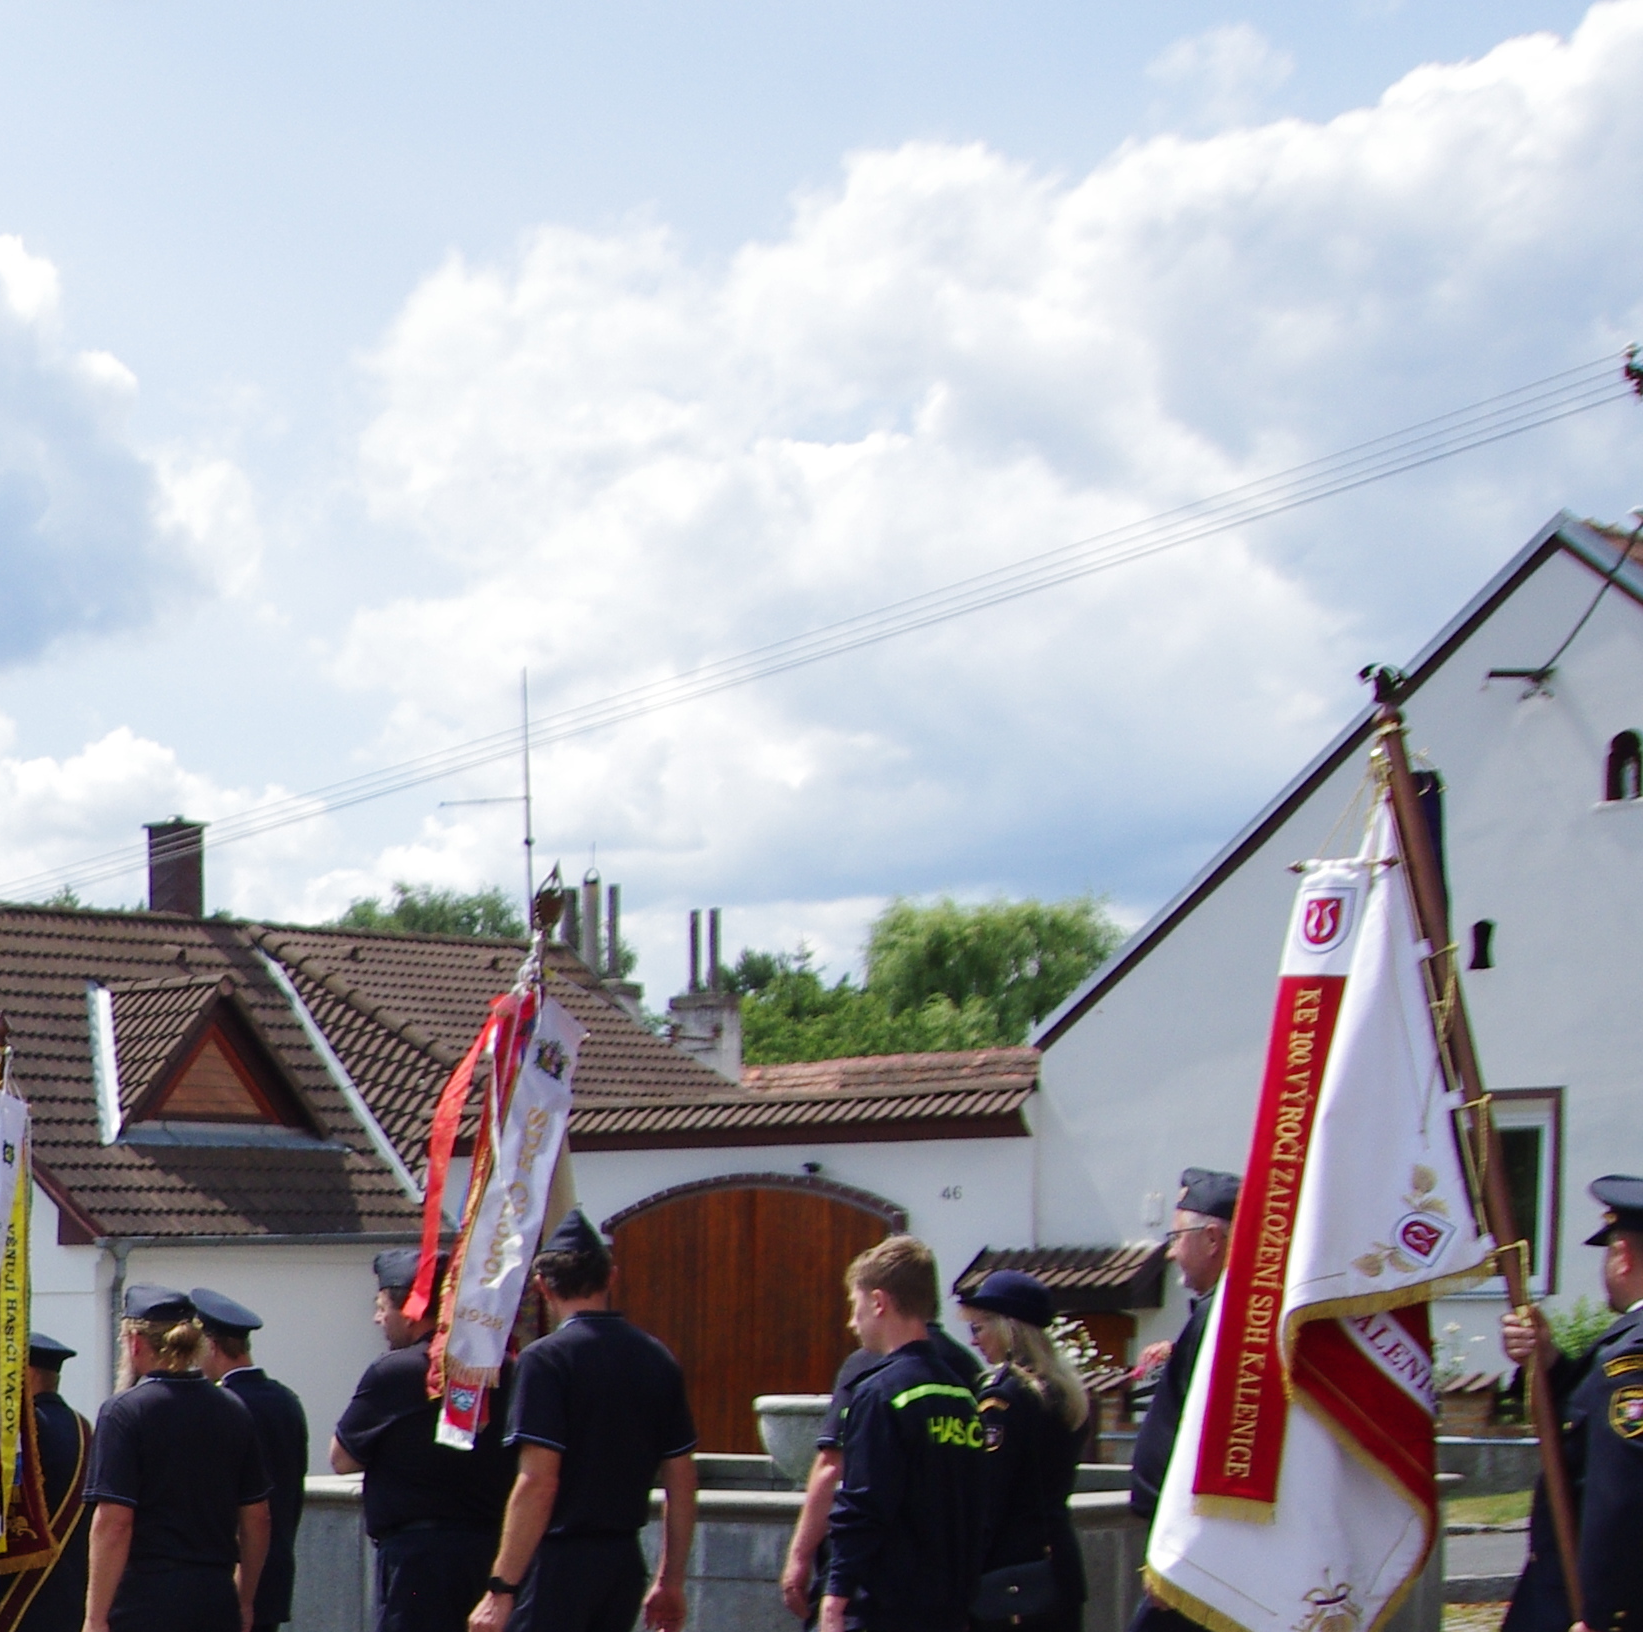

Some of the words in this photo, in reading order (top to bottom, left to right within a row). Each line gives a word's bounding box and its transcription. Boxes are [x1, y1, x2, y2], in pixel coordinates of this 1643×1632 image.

[1292, 987, 1323, 1025] KE
[1270, 1072, 1313, 1164] VÝROČÍ
[940, 1185, 964, 1201] 46
[4, 1223, 20, 1293] VĚNUJÍ
[1251, 1167, 1297, 1290] ZALOŽENÍ
[4, 1298, 19, 1363] HASIČI
[457, 1305, 505, 1331] 1928
[1243, 1293, 1274, 1344] SDH
[0, 1371, 18, 1435] VACOV
[1224, 1352, 1267, 1480] KALENICE
